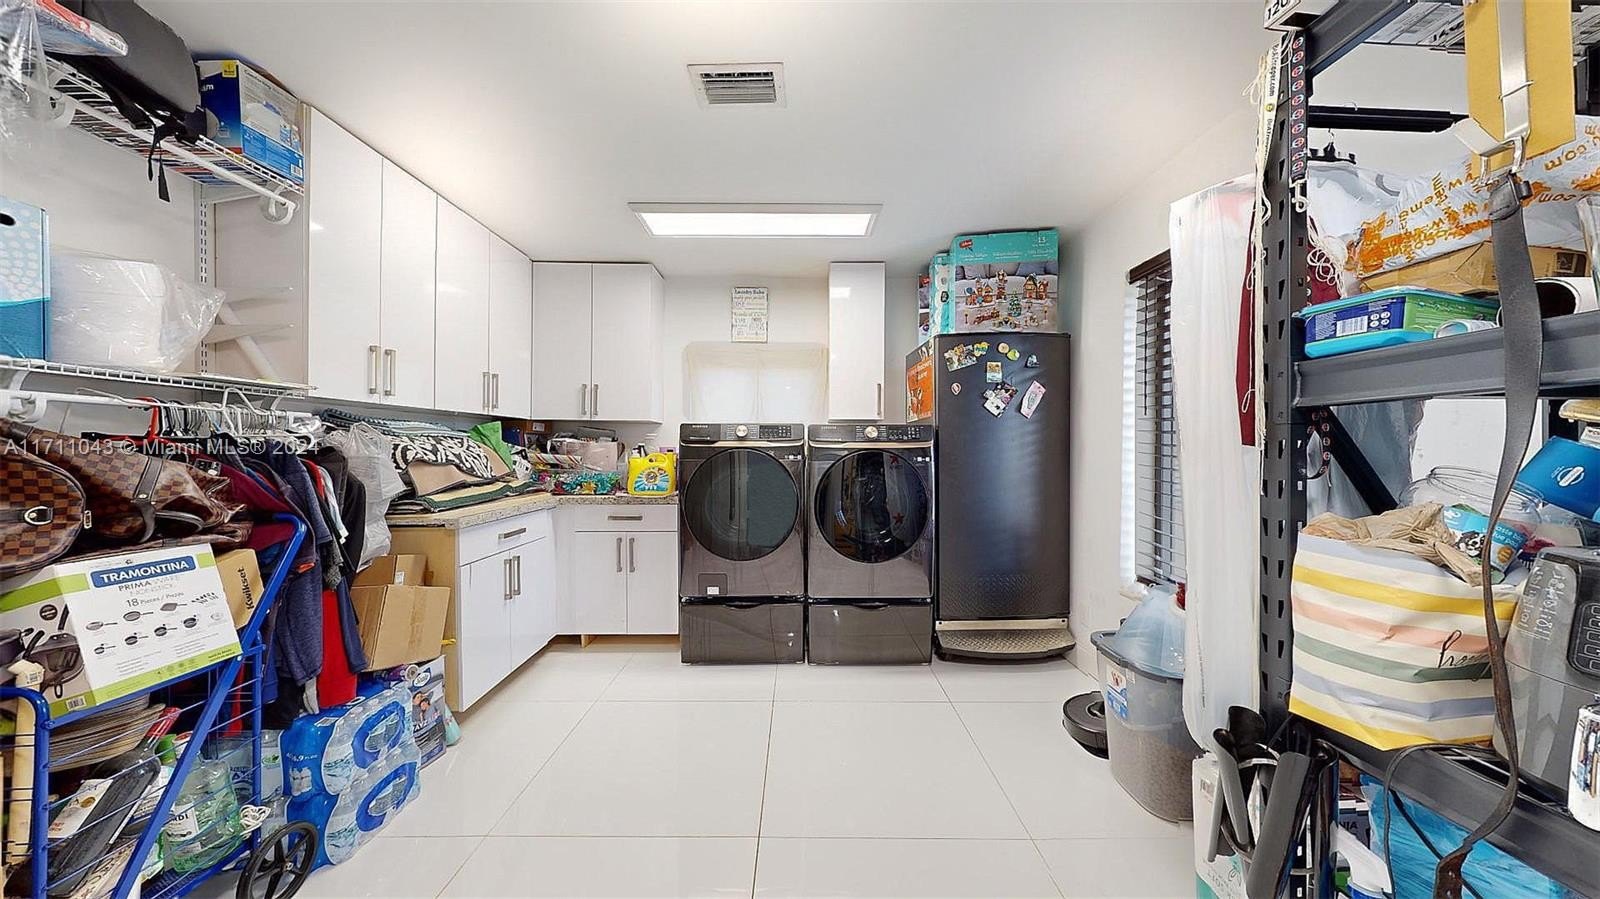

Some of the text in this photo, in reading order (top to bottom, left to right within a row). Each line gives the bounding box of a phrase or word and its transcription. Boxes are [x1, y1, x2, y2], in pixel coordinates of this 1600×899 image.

[100, 560, 190, 584] TRAMONTINA
[237, 567, 255, 610] Kwikset
[126, 598, 140, 608] 18
